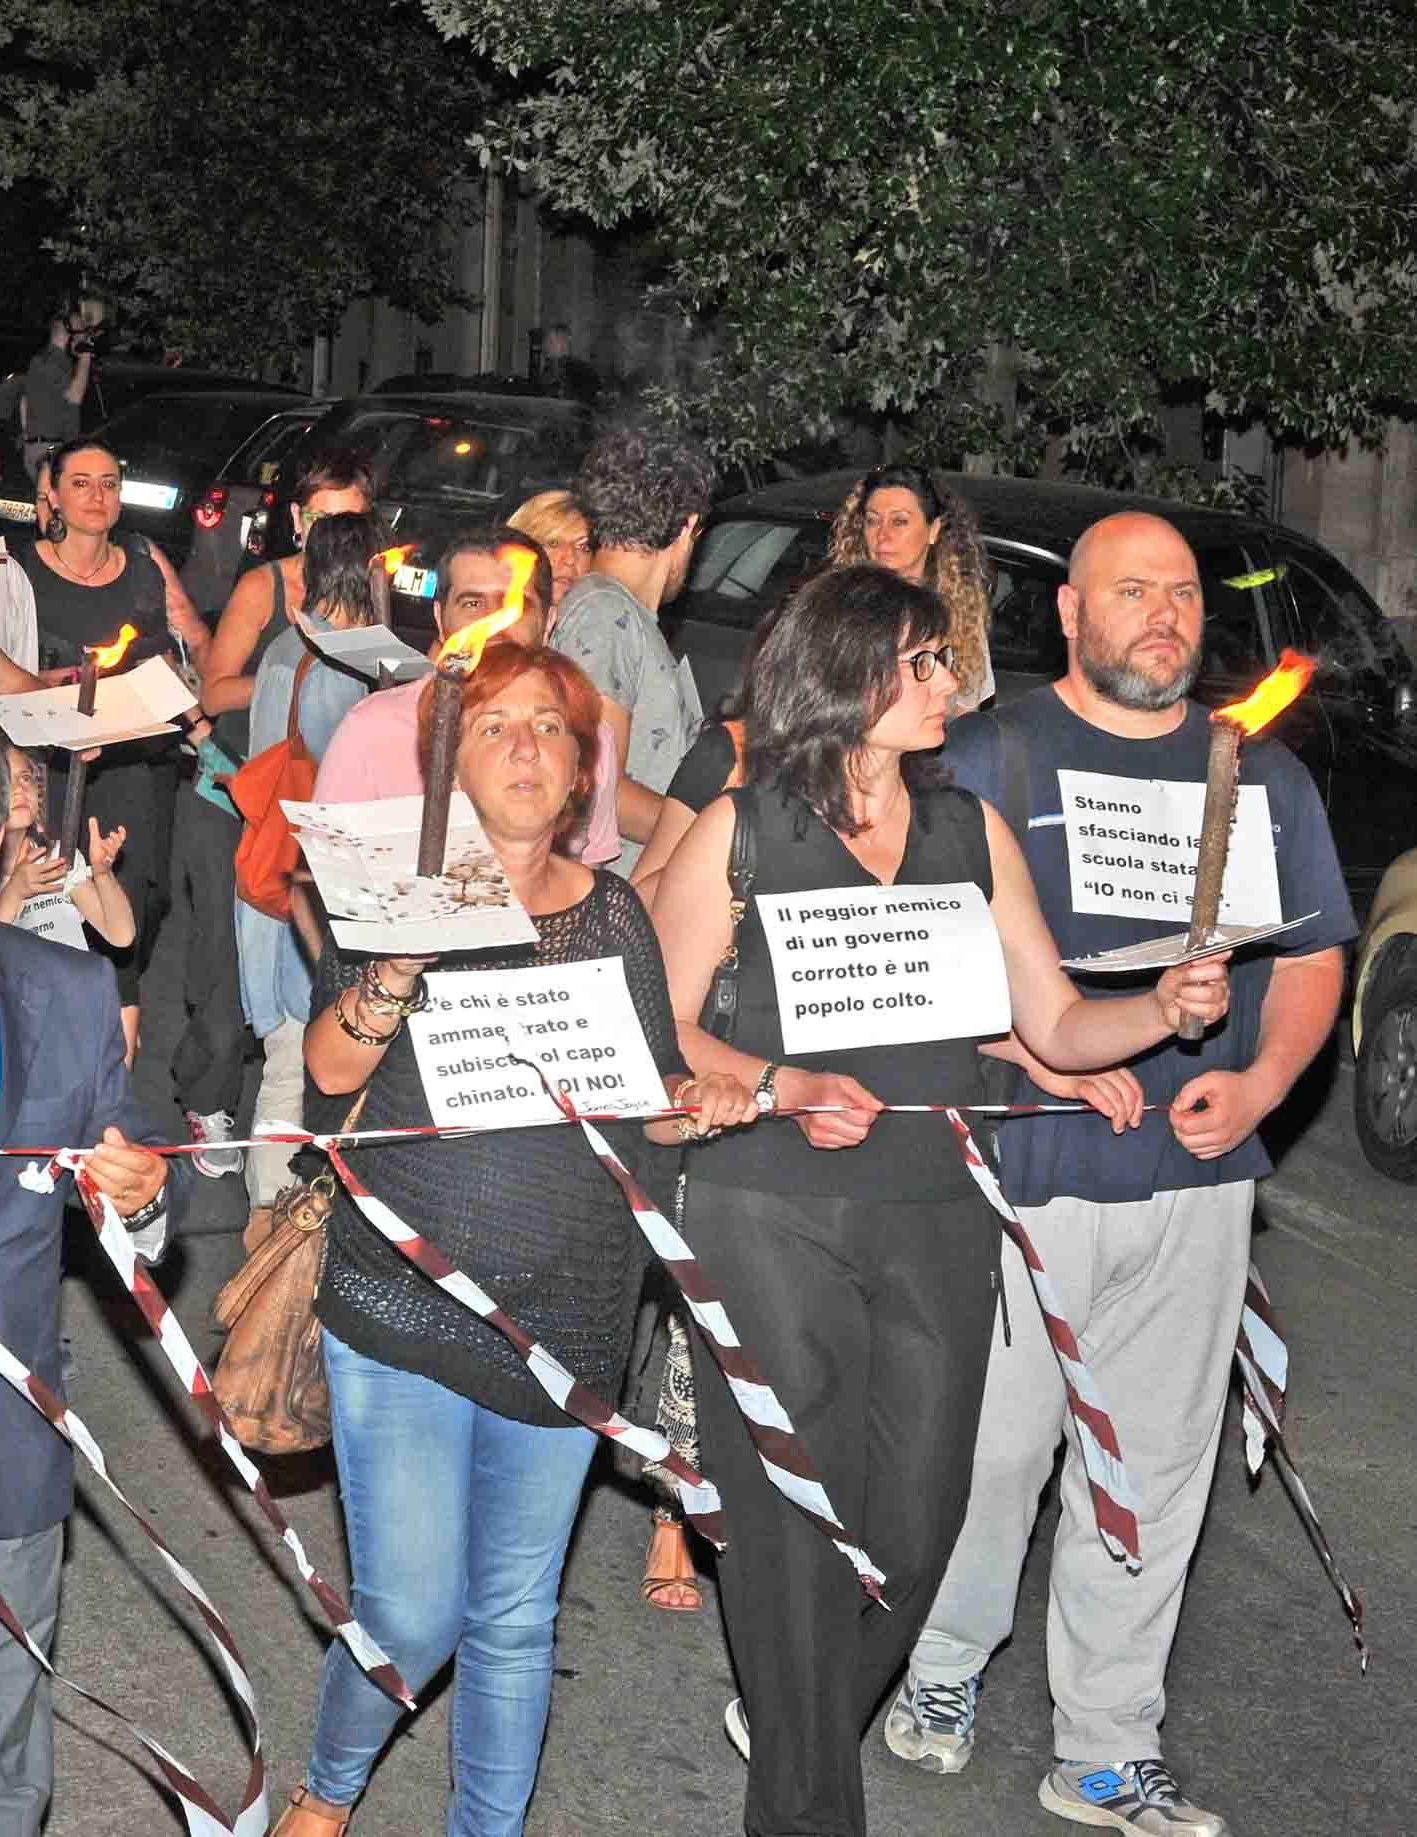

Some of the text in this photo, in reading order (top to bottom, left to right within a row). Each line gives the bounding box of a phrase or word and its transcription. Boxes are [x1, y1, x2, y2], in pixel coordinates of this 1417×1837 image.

[1074, 795, 1142, 814] Stanno
[1078, 823, 1181, 848] sfasciando
[1081, 853, 1198, 876] scuola stata
[1121, 887, 1155, 902] non
[1162, 891, 1178, 905] ci
[777, 898, 961, 923] Il peggior nemico
[785, 928, 929, 951] di un governo
[791, 959, 930, 983] corrotto è un
[460, 994, 491, 1009] chi
[516, 988, 570, 1007] stato
[795, 992, 933, 1019] popolo colto.
[428, 1017, 589, 1045] ammaerato e
[566, 1046, 616, 1062] capo
[445, 1082, 535, 1109] chinato.
[585, 1073, 625, 1092] NO!
